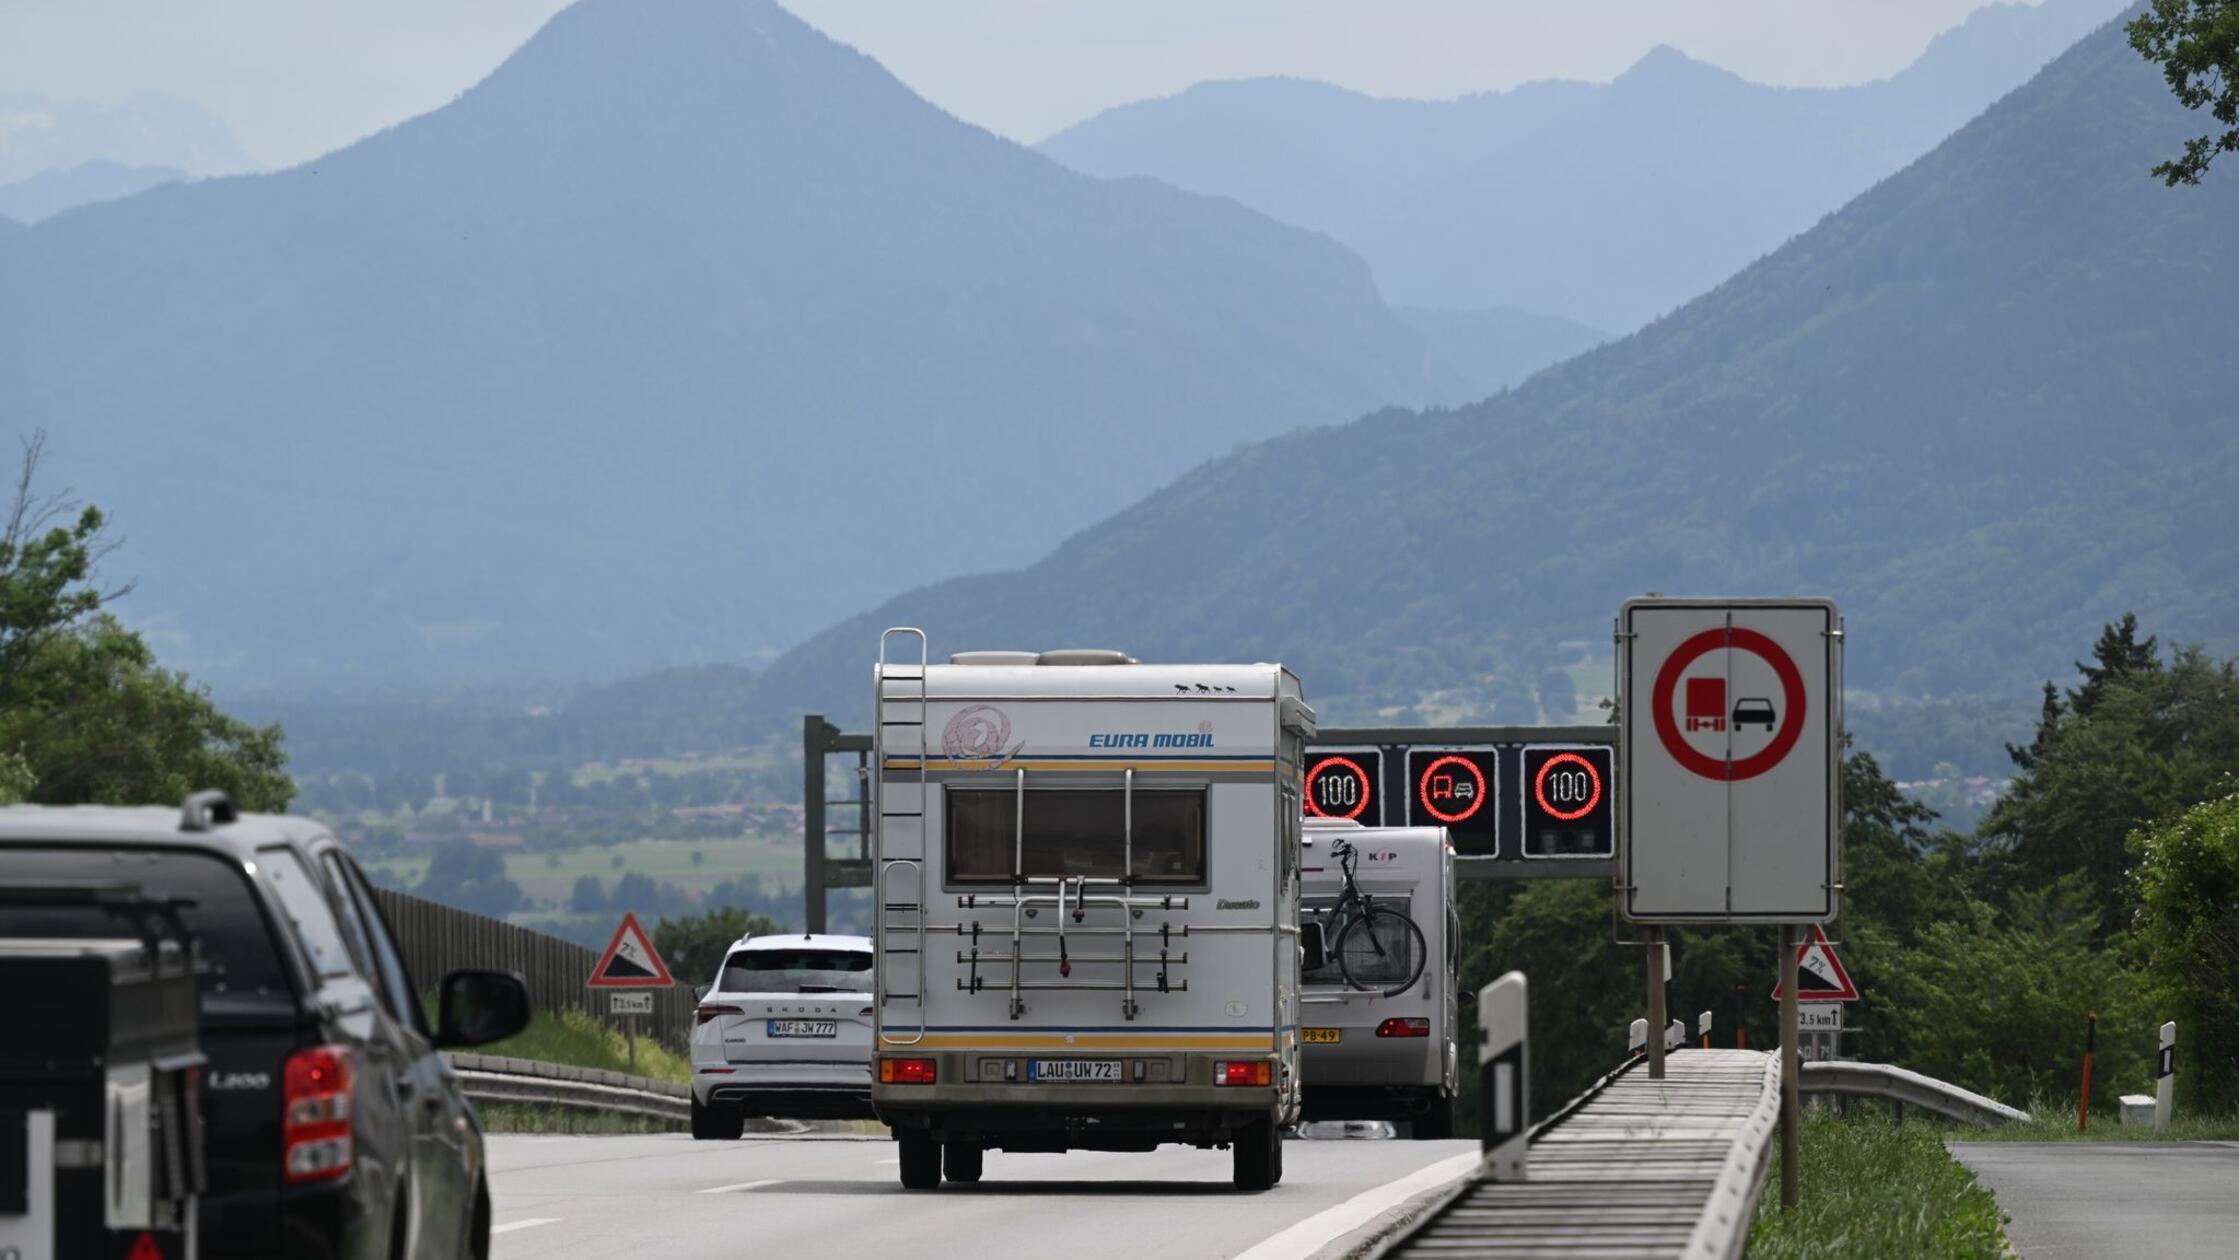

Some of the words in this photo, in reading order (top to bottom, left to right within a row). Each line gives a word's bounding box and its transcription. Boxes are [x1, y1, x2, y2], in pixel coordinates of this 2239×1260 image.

[1088, 733, 1146, 749] EURA
[1152, 733, 1215, 749] MOBIL
[1317, 775, 1356, 806] 100
[1548, 771, 1587, 802] 100
[1808, 956, 1827, 975] 7%
[775, 1020, 794, 1034] WAF
[801, 1020, 815, 1034] JW
[815, 1019, 835, 1034] 777
[1816, 1014, 1831, 1026] km
[1037, 1062, 1064, 1078] LAU
[1074, 1062, 1092, 1078] UW
[1094, 1062, 1112, 1078] 72
